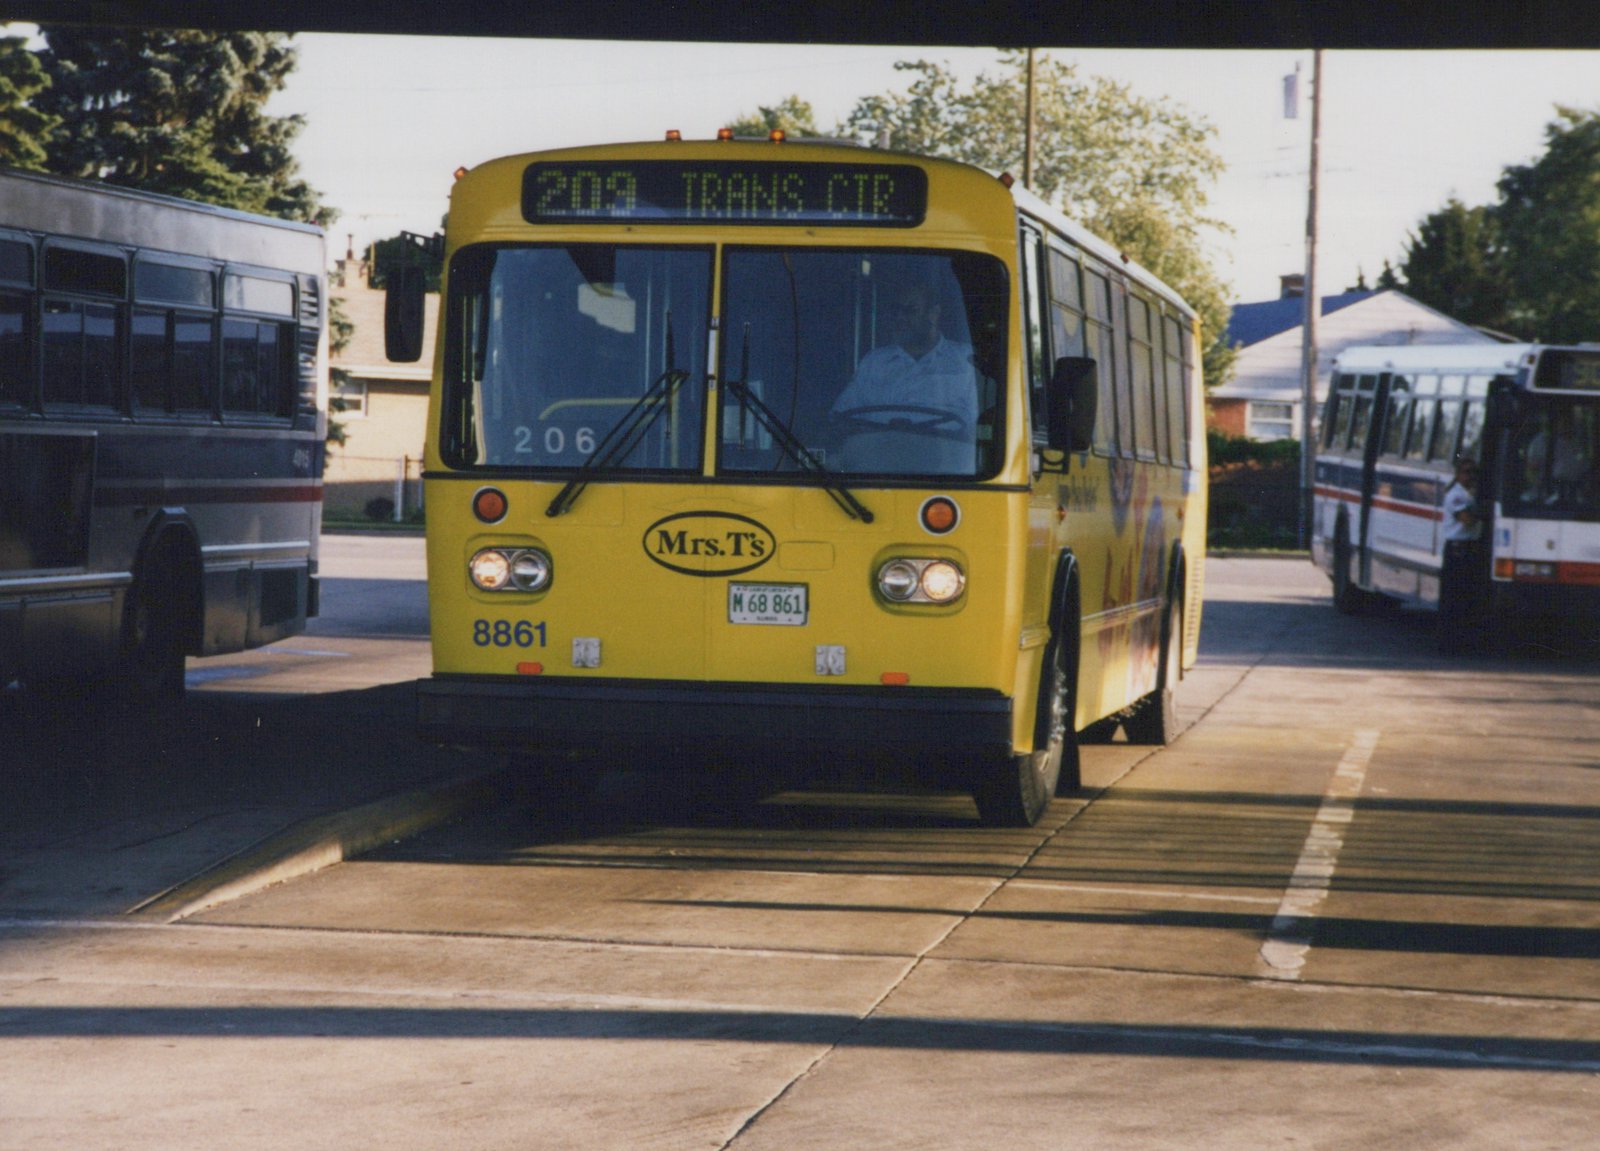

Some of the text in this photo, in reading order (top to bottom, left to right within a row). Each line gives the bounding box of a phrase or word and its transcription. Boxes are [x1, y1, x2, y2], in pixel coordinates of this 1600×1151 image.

[536, 170, 896, 219] 209 TRANS CTR
[733, 593, 743, 612] M
[473, 619, 547, 647] 8861
